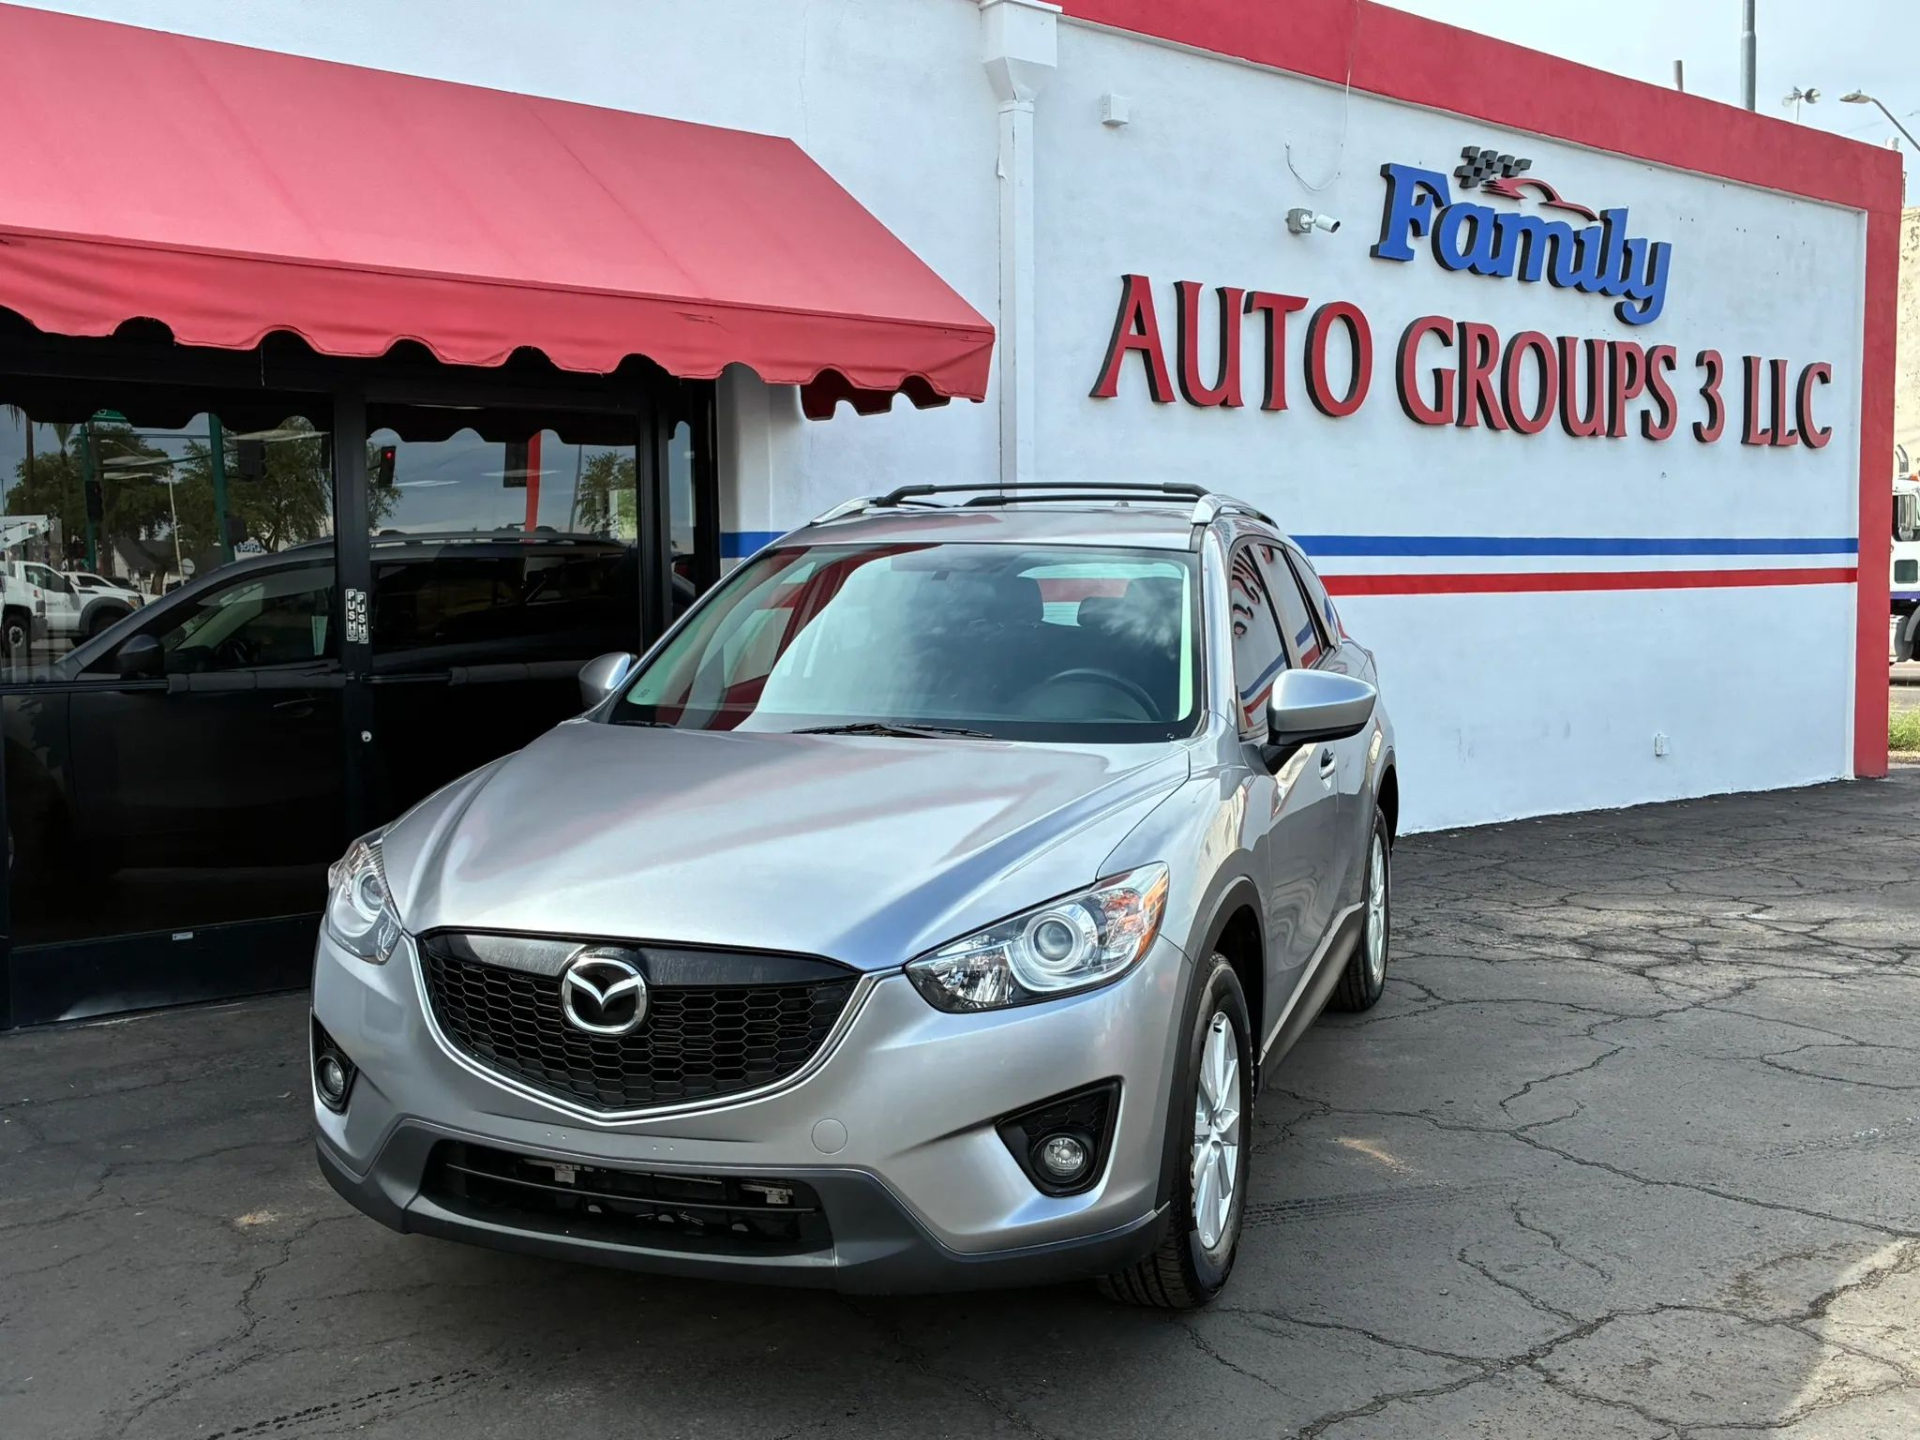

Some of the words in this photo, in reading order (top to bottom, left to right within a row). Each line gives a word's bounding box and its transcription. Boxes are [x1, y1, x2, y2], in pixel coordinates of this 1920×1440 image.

[1370, 162, 1672, 325] Family
[1089, 274, 1374, 417] AUTO
[1396, 315, 1677, 441] GROUPS
[1693, 350, 1725, 443] 3
[1742, 355, 1832, 448] LLC
[347, 591, 356, 630] PUSH
[357, 594, 366, 633] PUSH
